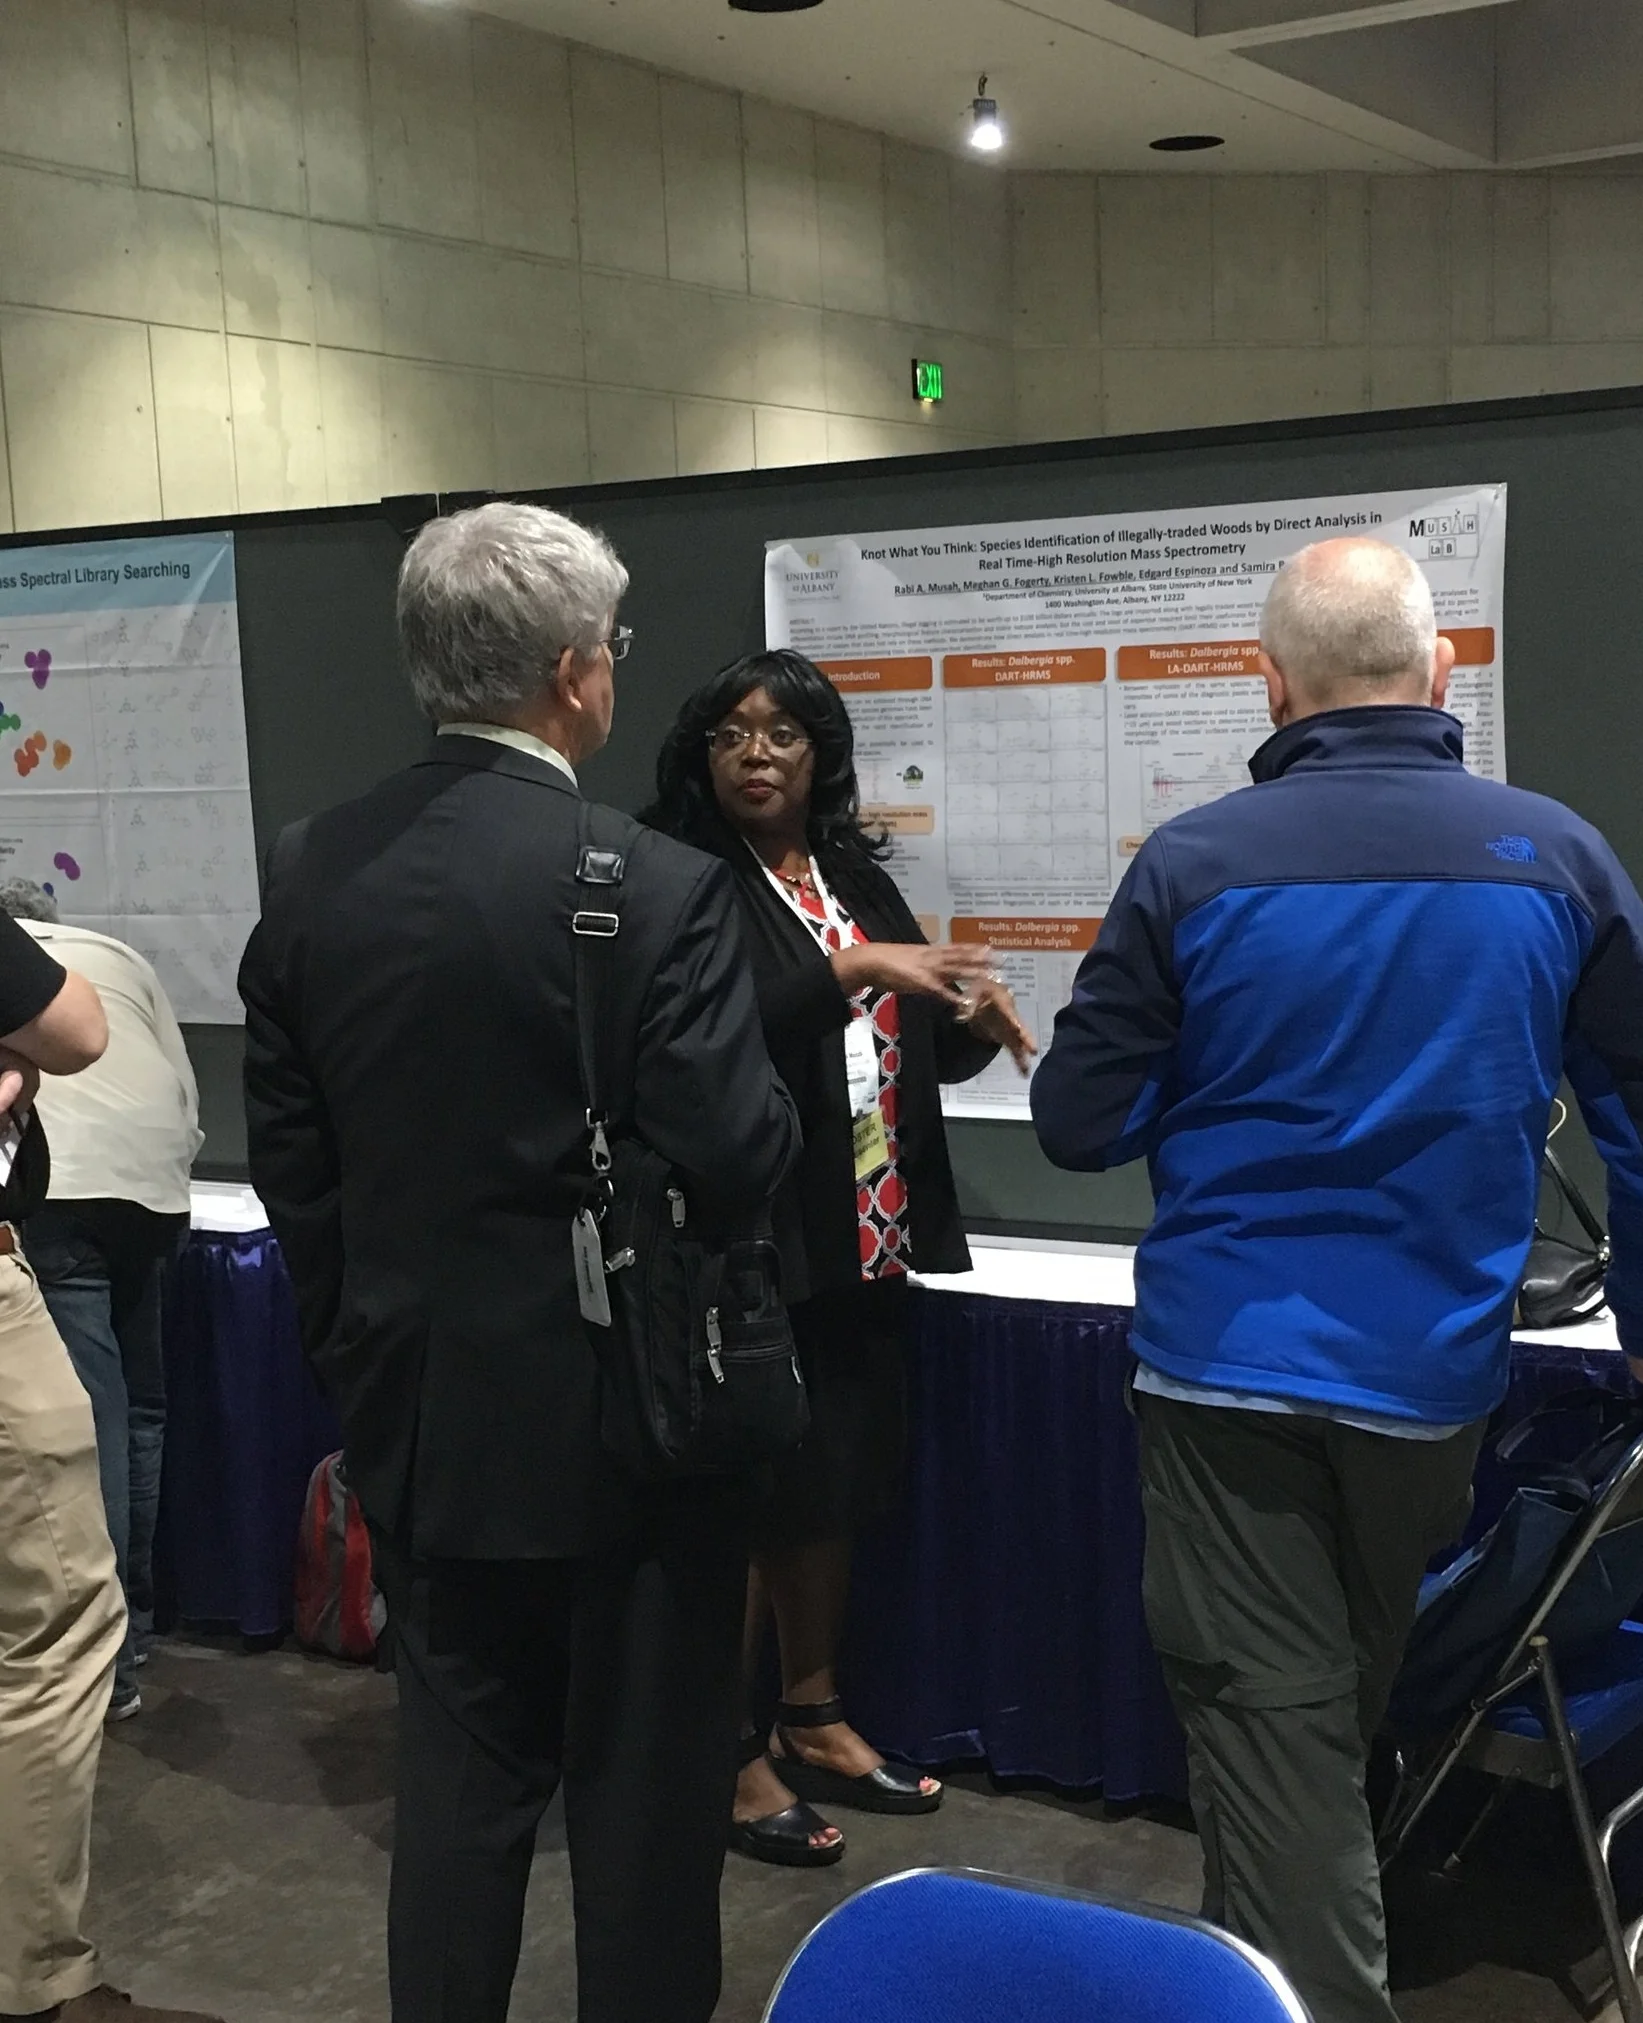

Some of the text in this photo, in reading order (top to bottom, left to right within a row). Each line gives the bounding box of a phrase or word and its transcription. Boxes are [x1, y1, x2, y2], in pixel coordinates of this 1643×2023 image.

[920, 363, 942, 399] EXIT
[861, 511, 1382, 560] Knot What You Think: Species Identification of Illegally-traded Woods by Direct Analysis in
[979, 543, 1246, 570] Real Time-High Resolution Mass Spectrometry
[20, 569, 71, 590] Spectral
[75, 566, 119, 585] Library
[123, 561, 190, 580] Searching
[786, 570, 839, 582] UNIVERSITY
[895, 585, 914, 595] Rabi
[928, 582, 961, 593] Musah,
[963, 580, 1000, 592] Meghan
[1015, 576, 1051, 588] Fogerty,
[1054, 573, 1086, 585] Kristen
[1099, 570, 1136, 582] Fowble,
[1139, 567, 1172, 580] Edgard
[1174, 564, 1217, 577] Espinoza
[1220, 562, 1238, 574] and
[1241, 561, 1276, 573] Samira
[800, 583, 835, 594] ALBANY
[1028, 590, 1036, 599] of
[1075, 587, 1109, 597] University
[1149, 582, 1167, 591] State
[1169, 580, 1205, 591] University
[1207, 579, 1216, 588] of
[1236, 578, 1253, 586] York
[1063, 598, 1105, 609] Washington
[1150, 648, 1188, 660] Results:
[1190, 646, 1239, 658] Dalbergia
[972, 655, 1075, 668] Results: Dalbergia spp.
[1168, 661, 1244, 674] LA-DART-HRMS
[828, 671, 881, 682] Introduction
[995, 670, 1051, 682] DART-HRMS
[978, 921, 1081, 934] Results: Dalbergia spp.
[988, 936, 1071, 949] Statistical Analysis
